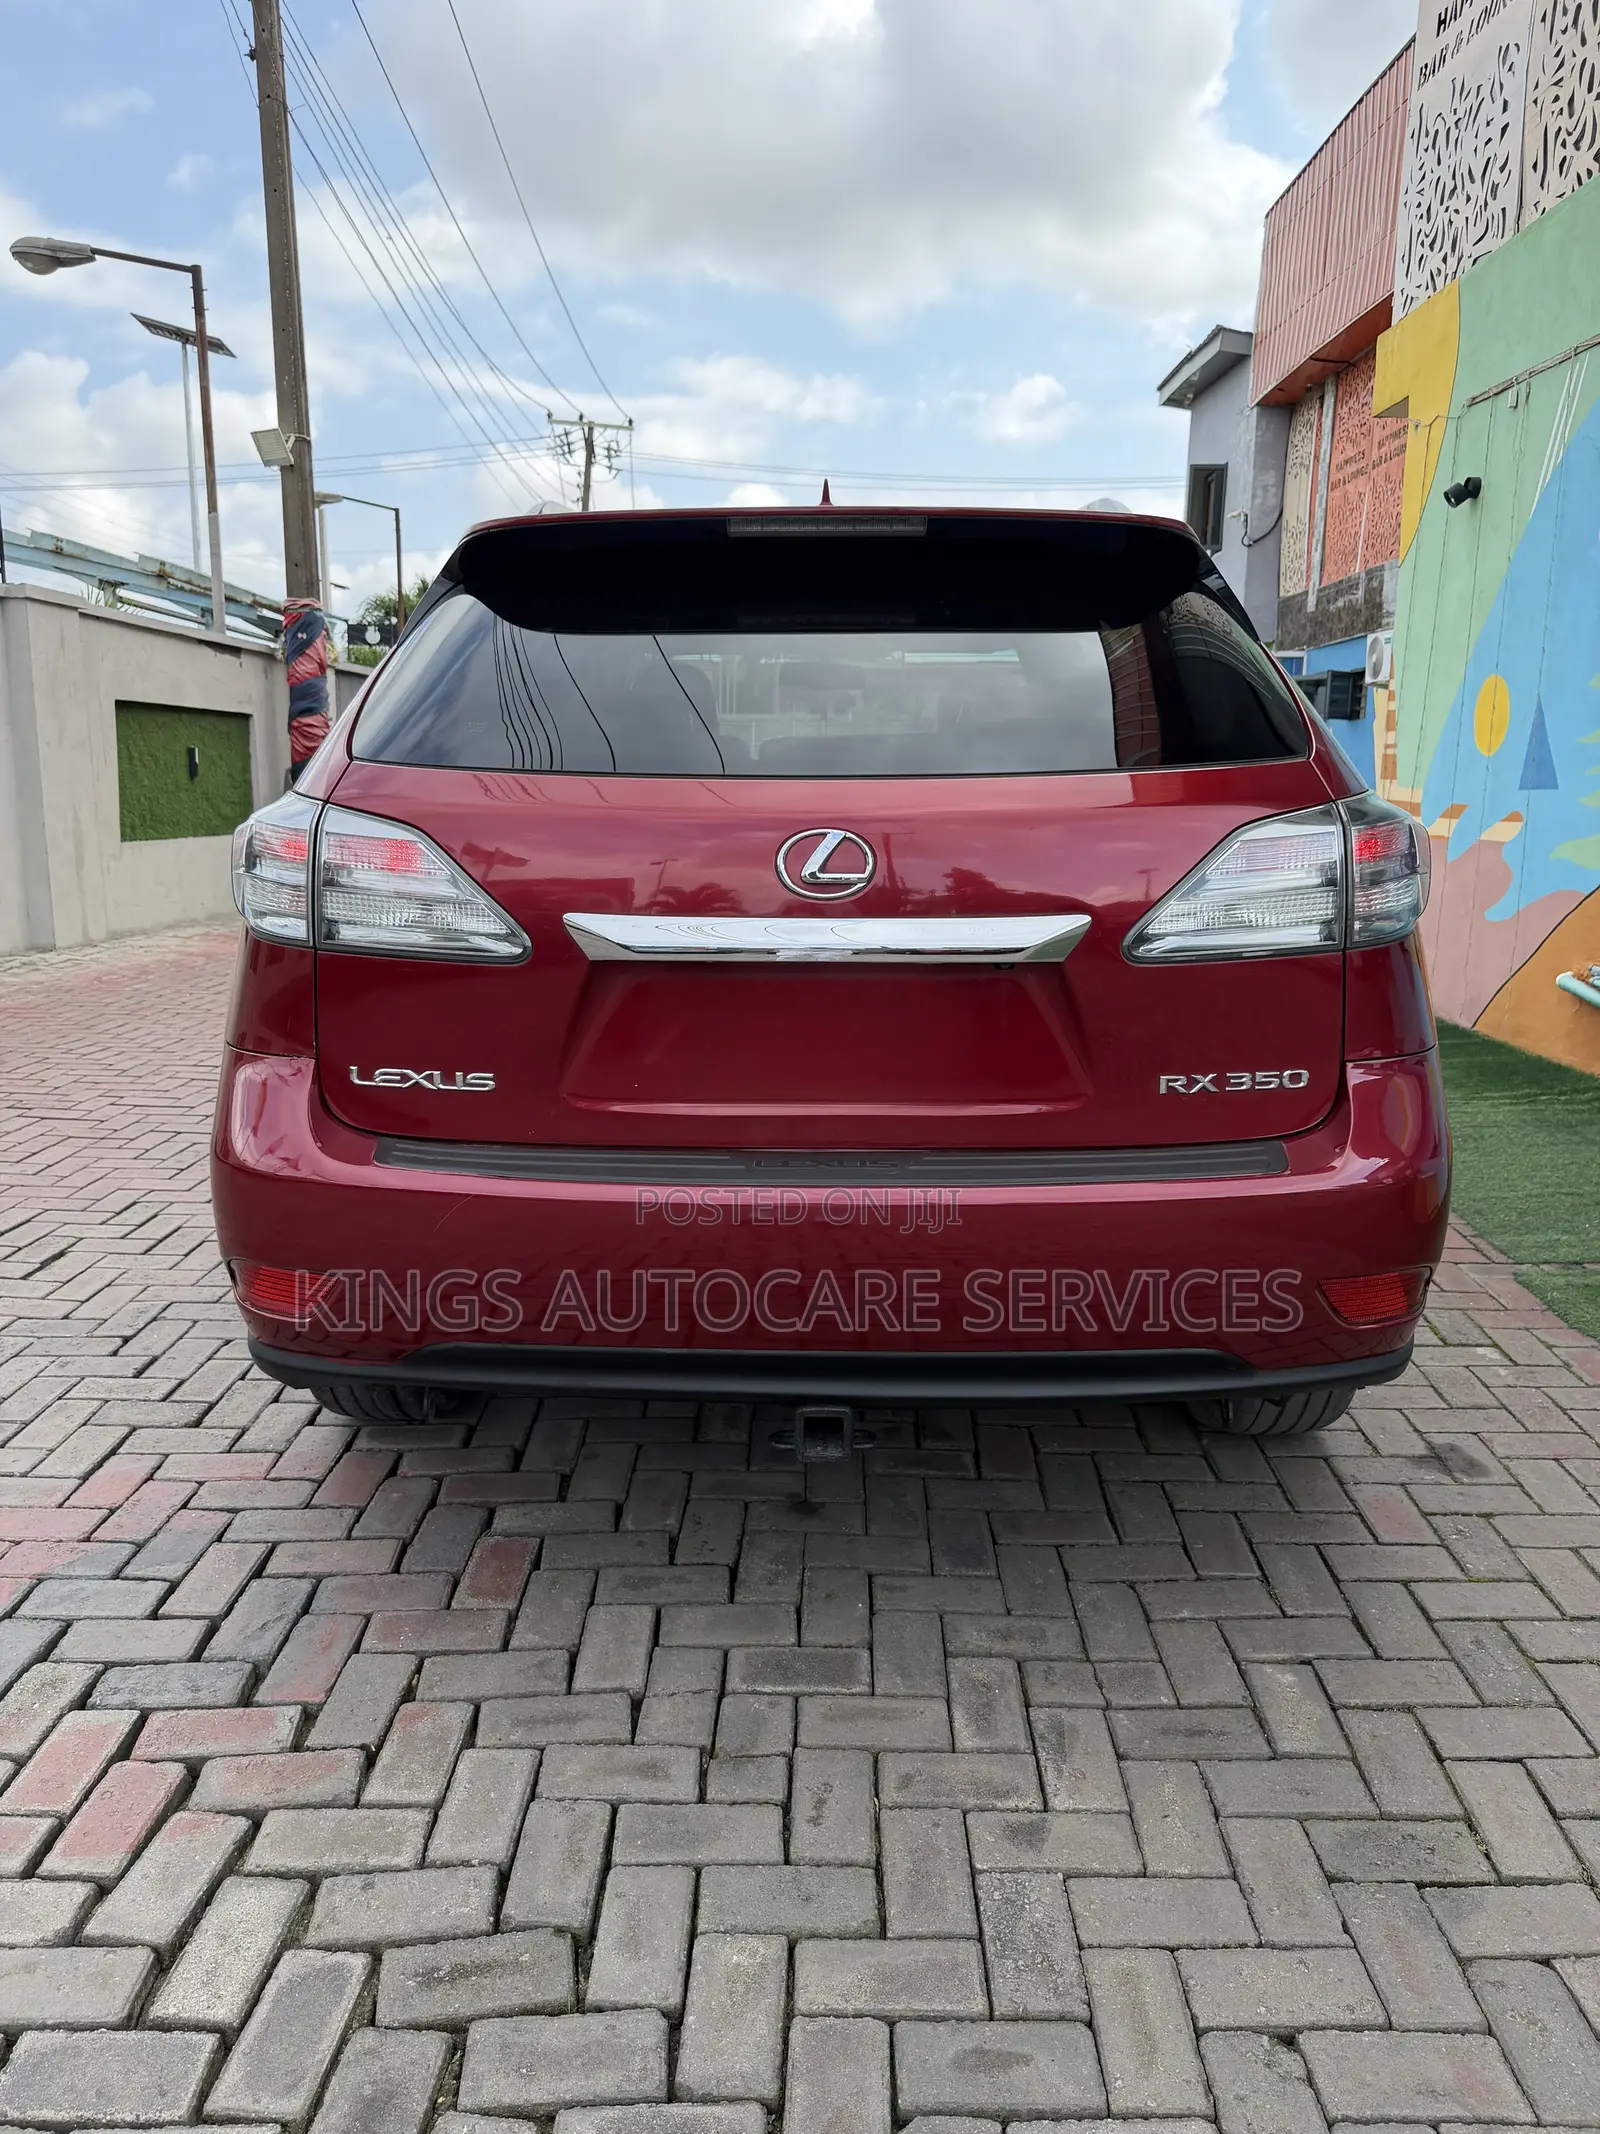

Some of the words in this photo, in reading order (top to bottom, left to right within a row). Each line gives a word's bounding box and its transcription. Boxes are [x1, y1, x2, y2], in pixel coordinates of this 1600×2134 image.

[1417, 43, 1450, 91] BAR
[1451, 30, 1464, 59] &
[350, 1066, 496, 1091] LEXUS
[1159, 1073, 1220, 1095] RX
[1225, 1069, 1310, 1092] 350
[752, 1159, 900, 1169] LEXUS
